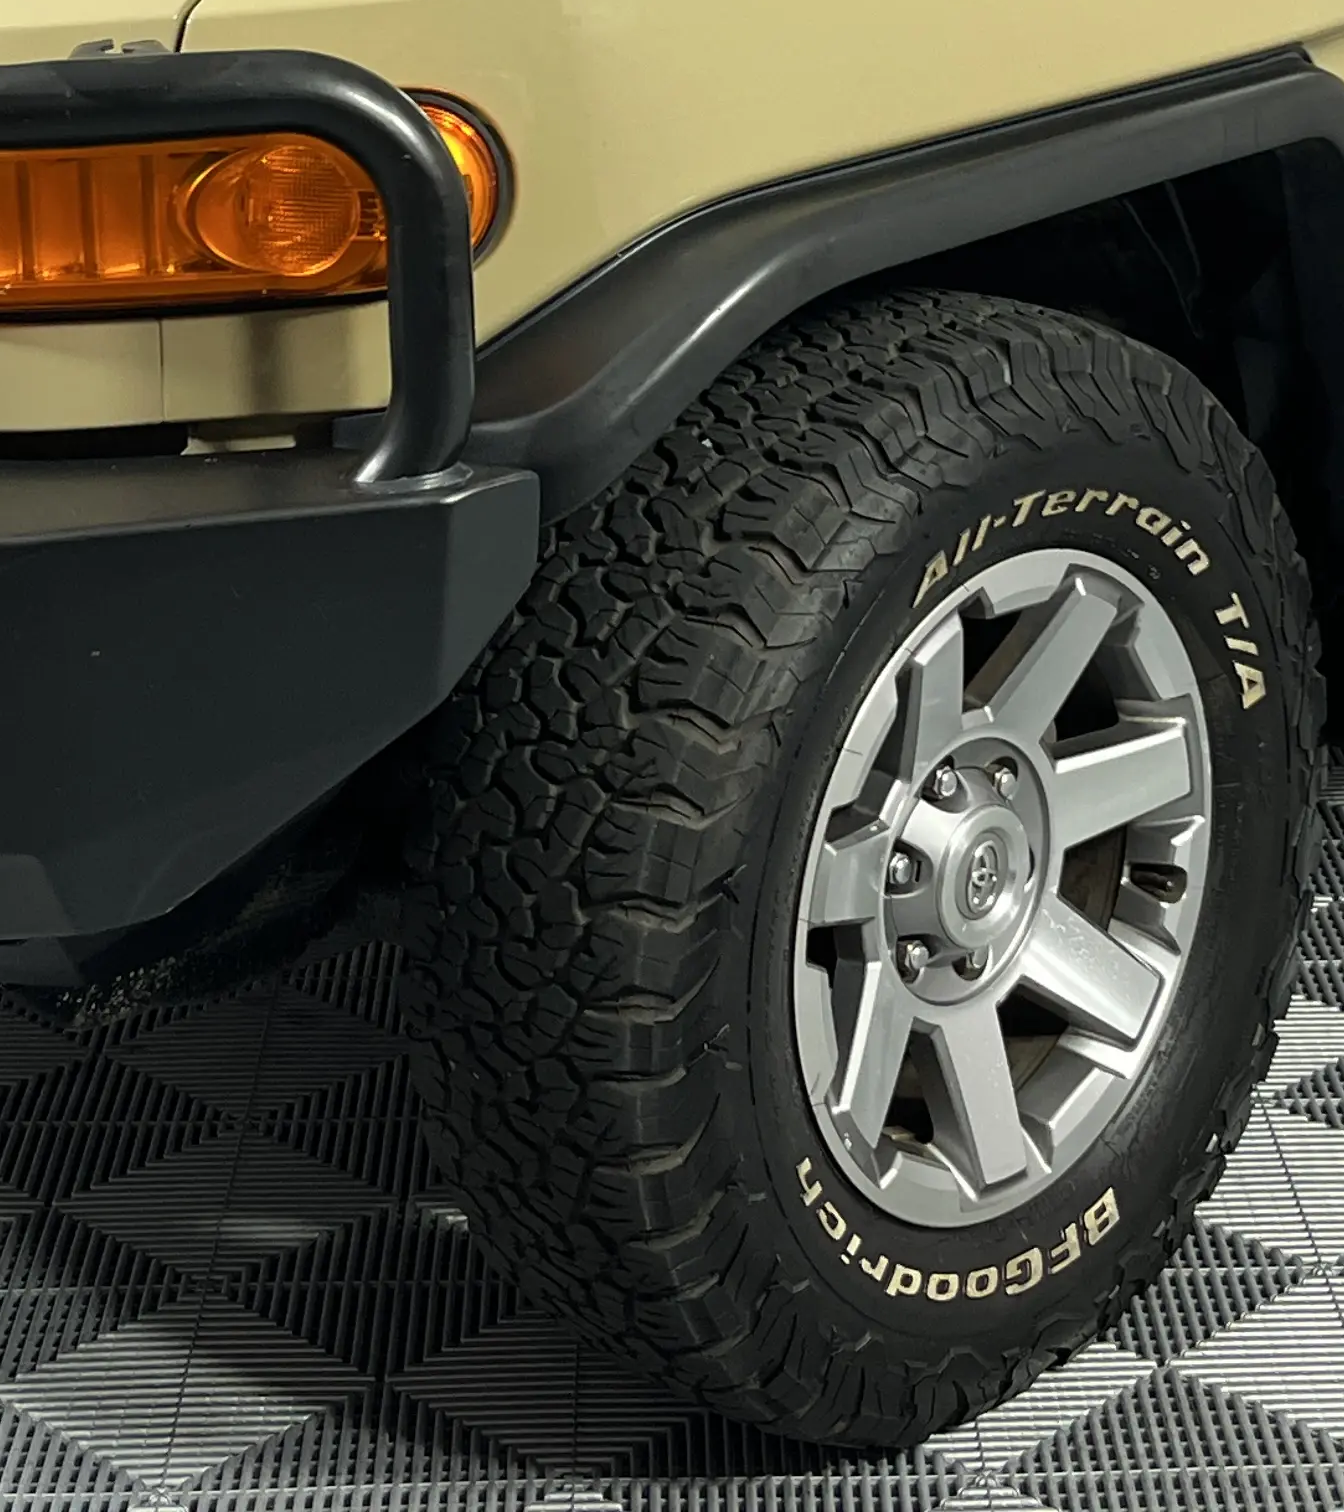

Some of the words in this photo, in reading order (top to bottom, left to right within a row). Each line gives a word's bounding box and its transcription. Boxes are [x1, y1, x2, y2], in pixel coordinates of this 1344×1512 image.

[911, 487, 1211, 609] All-Terrain
[1213, 591, 1268, 710] T/A
[794, 1156, 1121, 1302] BFGoodrich
